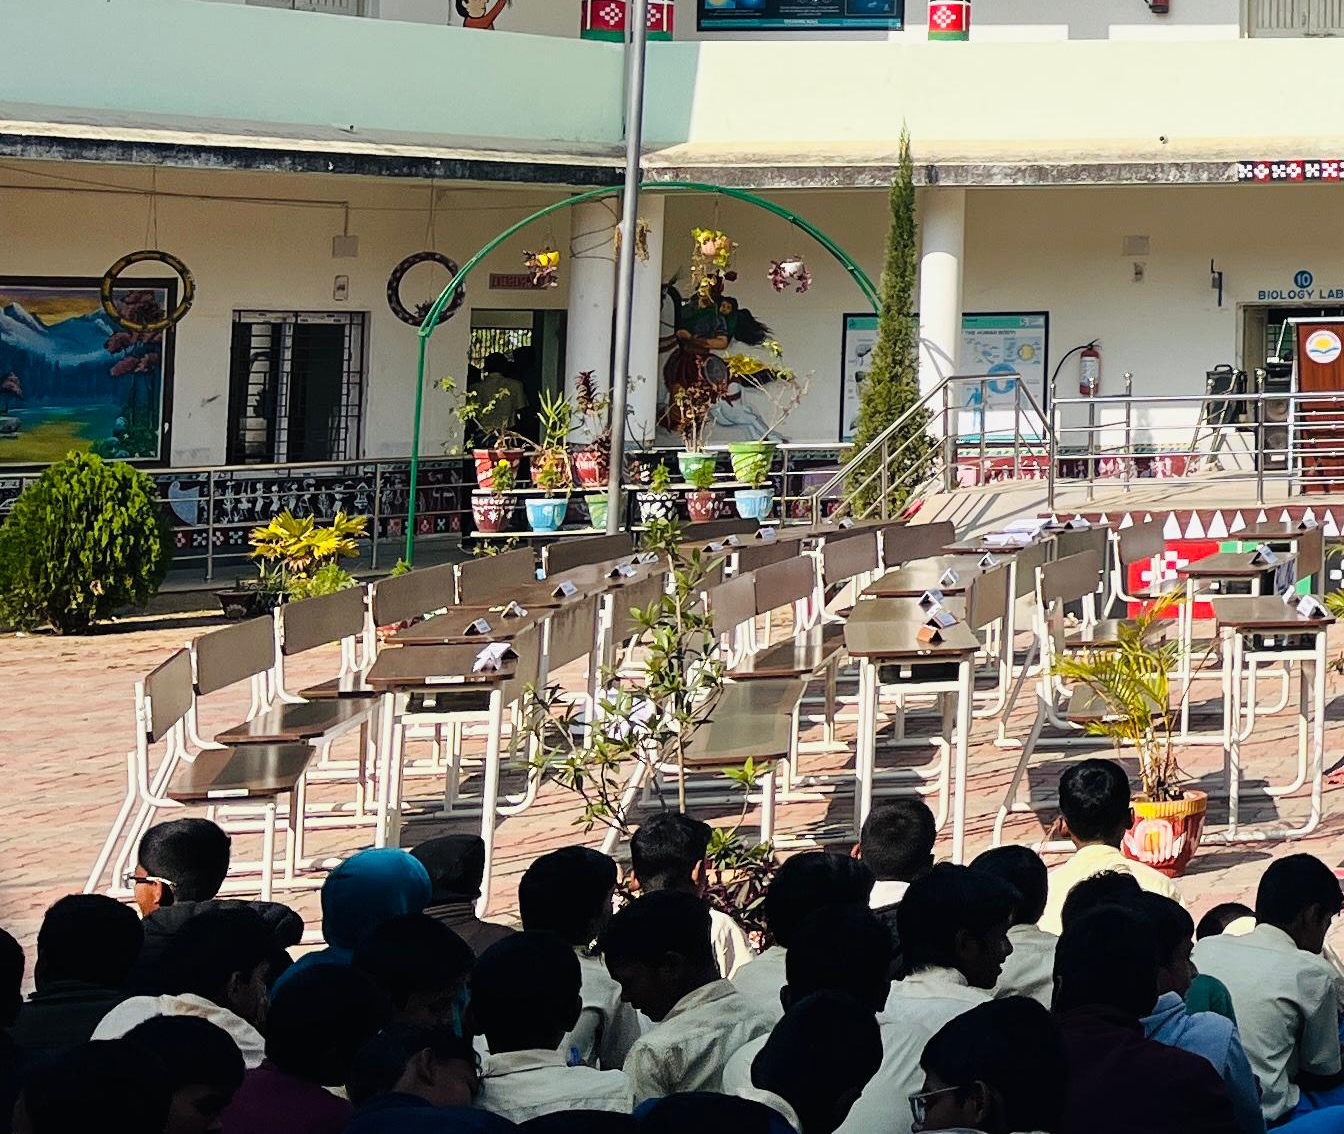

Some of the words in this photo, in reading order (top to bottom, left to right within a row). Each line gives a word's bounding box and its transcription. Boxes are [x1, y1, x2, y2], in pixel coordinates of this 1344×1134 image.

[1297, 273, 1311, 286] 10
[1258, 289, 1315, 300] BIOLOGY
[1319, 288, 1344, 299] LAB
